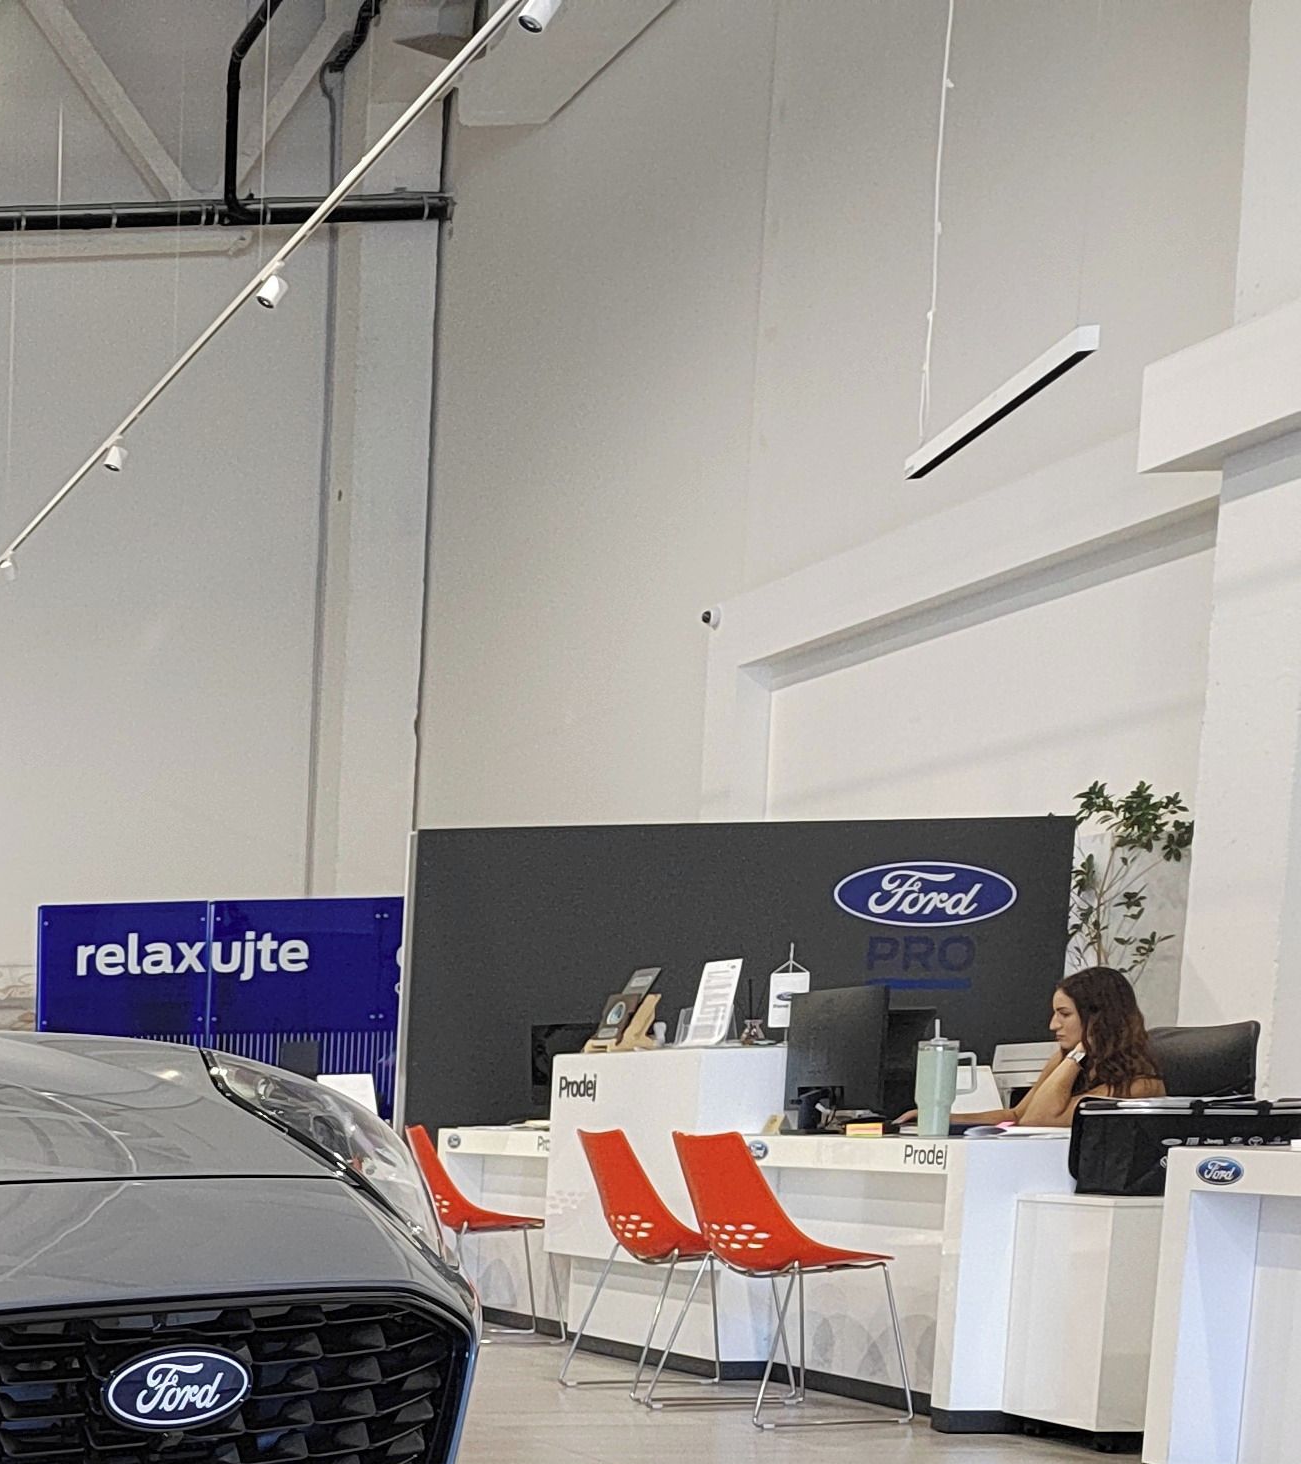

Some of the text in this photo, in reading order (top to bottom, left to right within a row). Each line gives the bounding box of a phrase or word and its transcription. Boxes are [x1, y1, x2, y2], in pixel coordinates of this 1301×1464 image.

[868, 870, 983, 915] Ford
[77, 931, 309, 981] relaxujte
[866, 935, 976, 972] PRO
[558, 1074, 597, 1102] Prodej
[903, 1144, 949, 1170] Prodej
[136, 1363, 225, 1414] Ford
